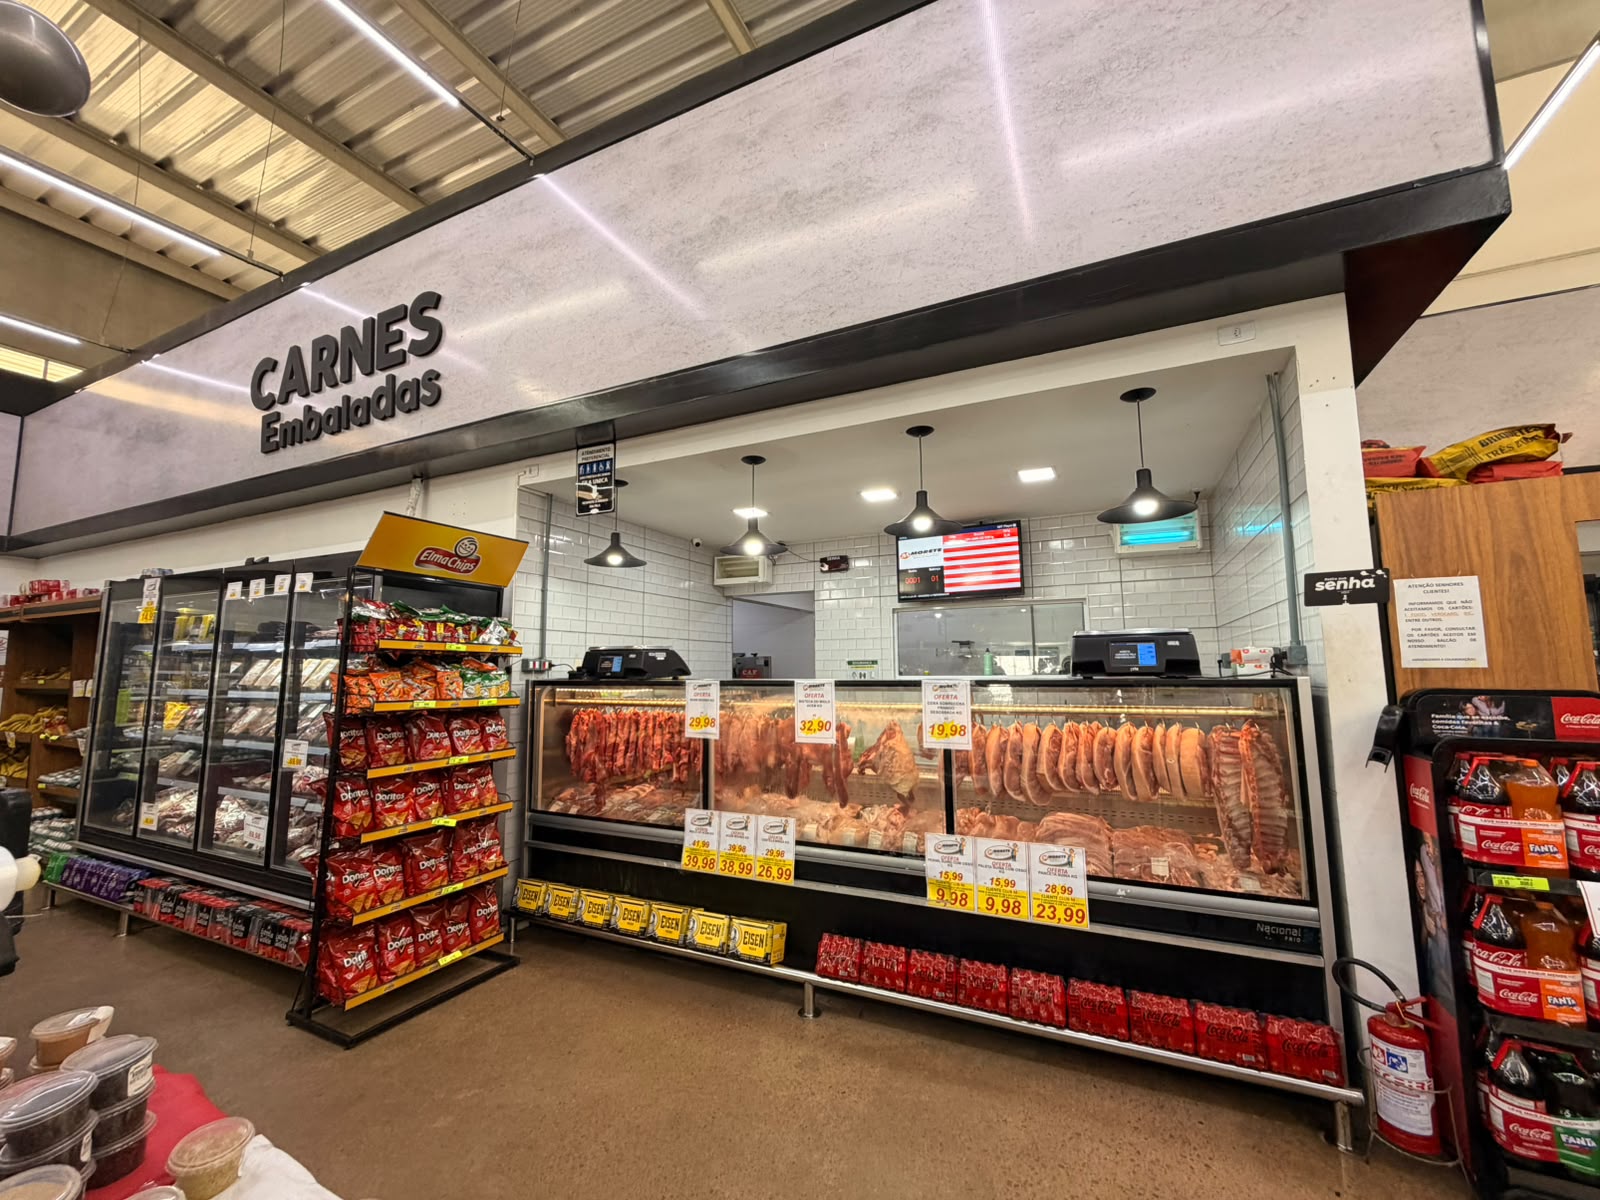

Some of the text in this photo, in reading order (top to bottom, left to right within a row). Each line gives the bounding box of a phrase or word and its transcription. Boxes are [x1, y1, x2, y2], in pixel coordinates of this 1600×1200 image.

[250, 290, 443, 411] CARNES
[260, 368, 442, 454] Embaladas
[581, 447, 611, 456] ATENDIMENTO
[581, 453, 610, 462] PREFERENCIAL
[1484, 444, 1514, 459] TRÊS
[1314, 576, 1375, 591] senha
[689, 716, 716, 729] 29,98
[800, 720, 832, 733] 32,90
[929, 723, 967, 738] 19,98
[375, 792, 405, 801] Doritos
[727, 843, 747, 853] 39,98
[765, 848, 786, 858] 29,98
[1529, 844, 1559, 853] FANTA
[684, 854, 716, 870] 39,98
[720, 859, 753, 876] 38,99
[758, 864, 792, 881] 26,99
[938, 870, 964, 882] 15,99
[989, 876, 1016, 889] 15,99
[1044, 883, 1074, 896] 28,99
[522, 887, 539, 904] EISEN
[553, 893, 571, 908] EISEN
[936, 887, 968, 907] 9,98
[587, 900, 605, 917] EISEN
[985, 896, 1022, 915] 9,98
[622, 907, 642, 923] EISEN
[1036, 903, 1086, 924] 23,99
[660, 914, 680, 931] EISEN
[699, 921, 722, 938] EISEN
[1256, 922, 1301, 937] Nacional
[742, 931, 765, 948] EISEN
[1547, 995, 1577, 1008] FANTA
[1560, 1134, 1598, 1148] FANTA
